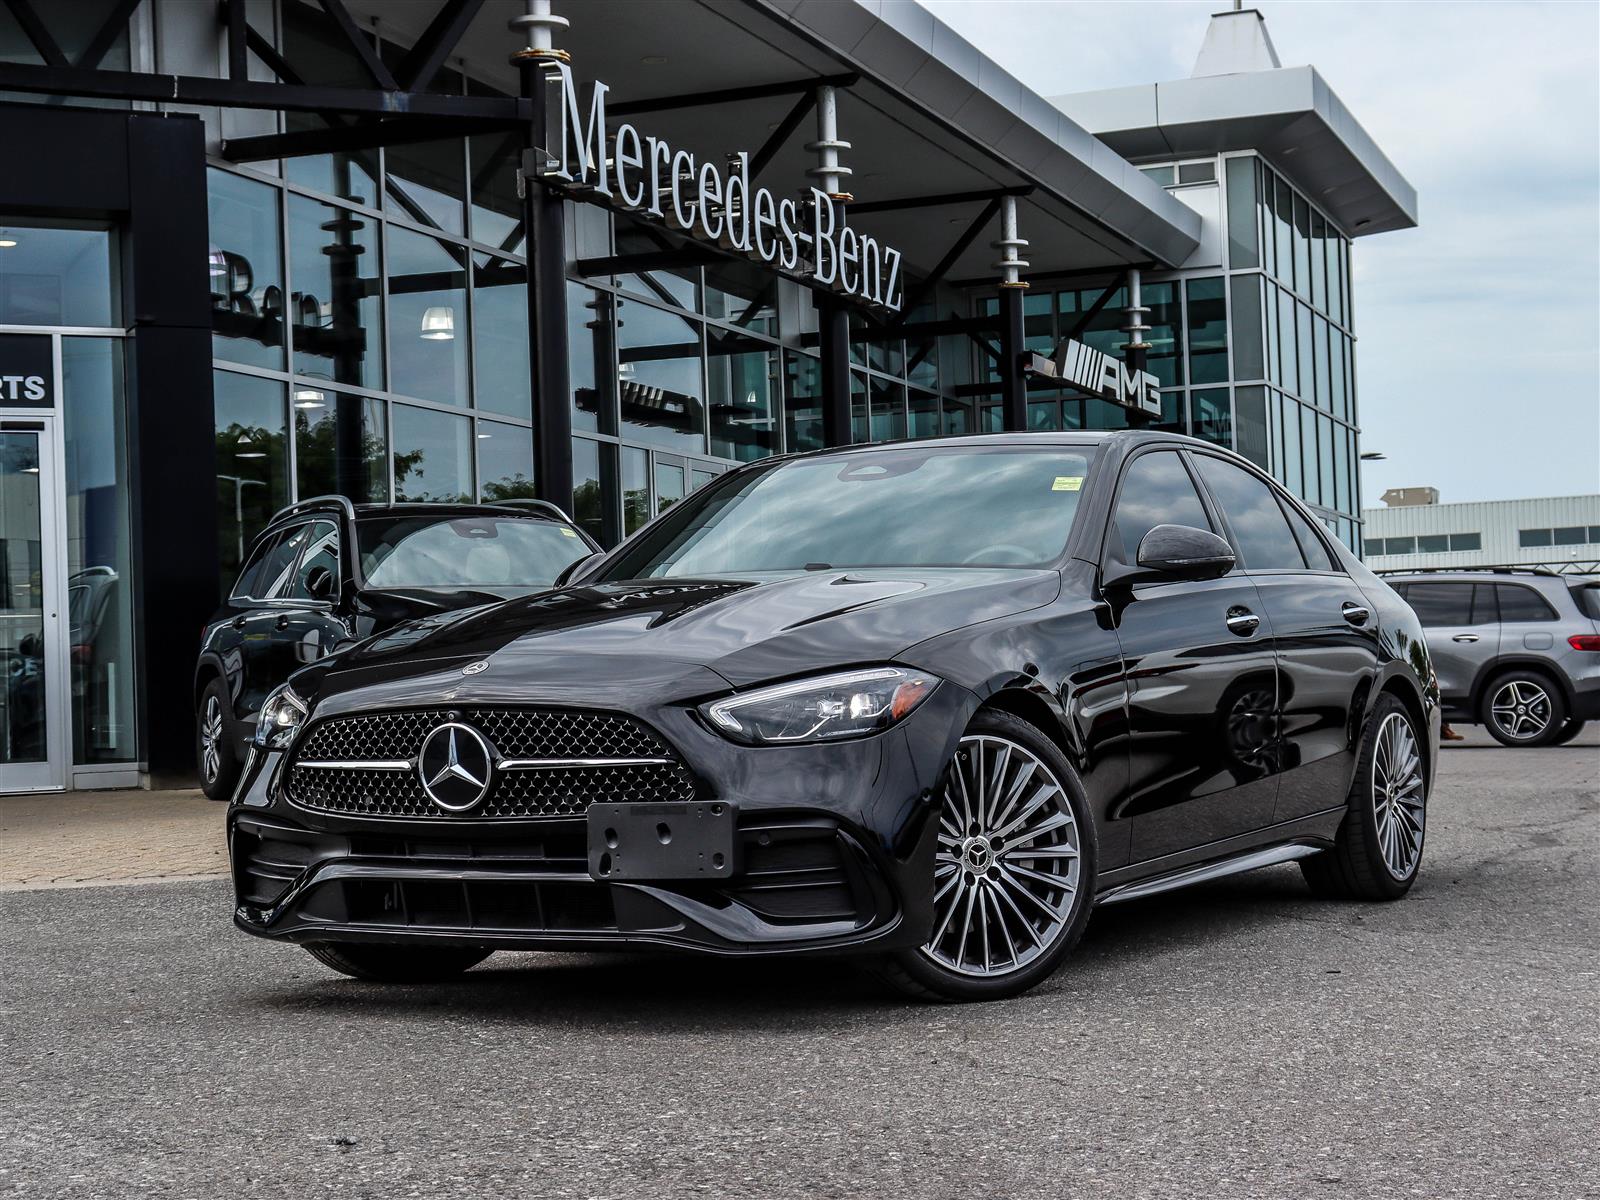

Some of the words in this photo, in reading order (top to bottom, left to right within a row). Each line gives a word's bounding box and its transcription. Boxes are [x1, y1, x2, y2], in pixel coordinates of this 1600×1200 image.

[555, 60, 902, 312] Mercedes-Benz
[0, 376, 45, 400] TS
[1097, 353, 1161, 416] AMG
